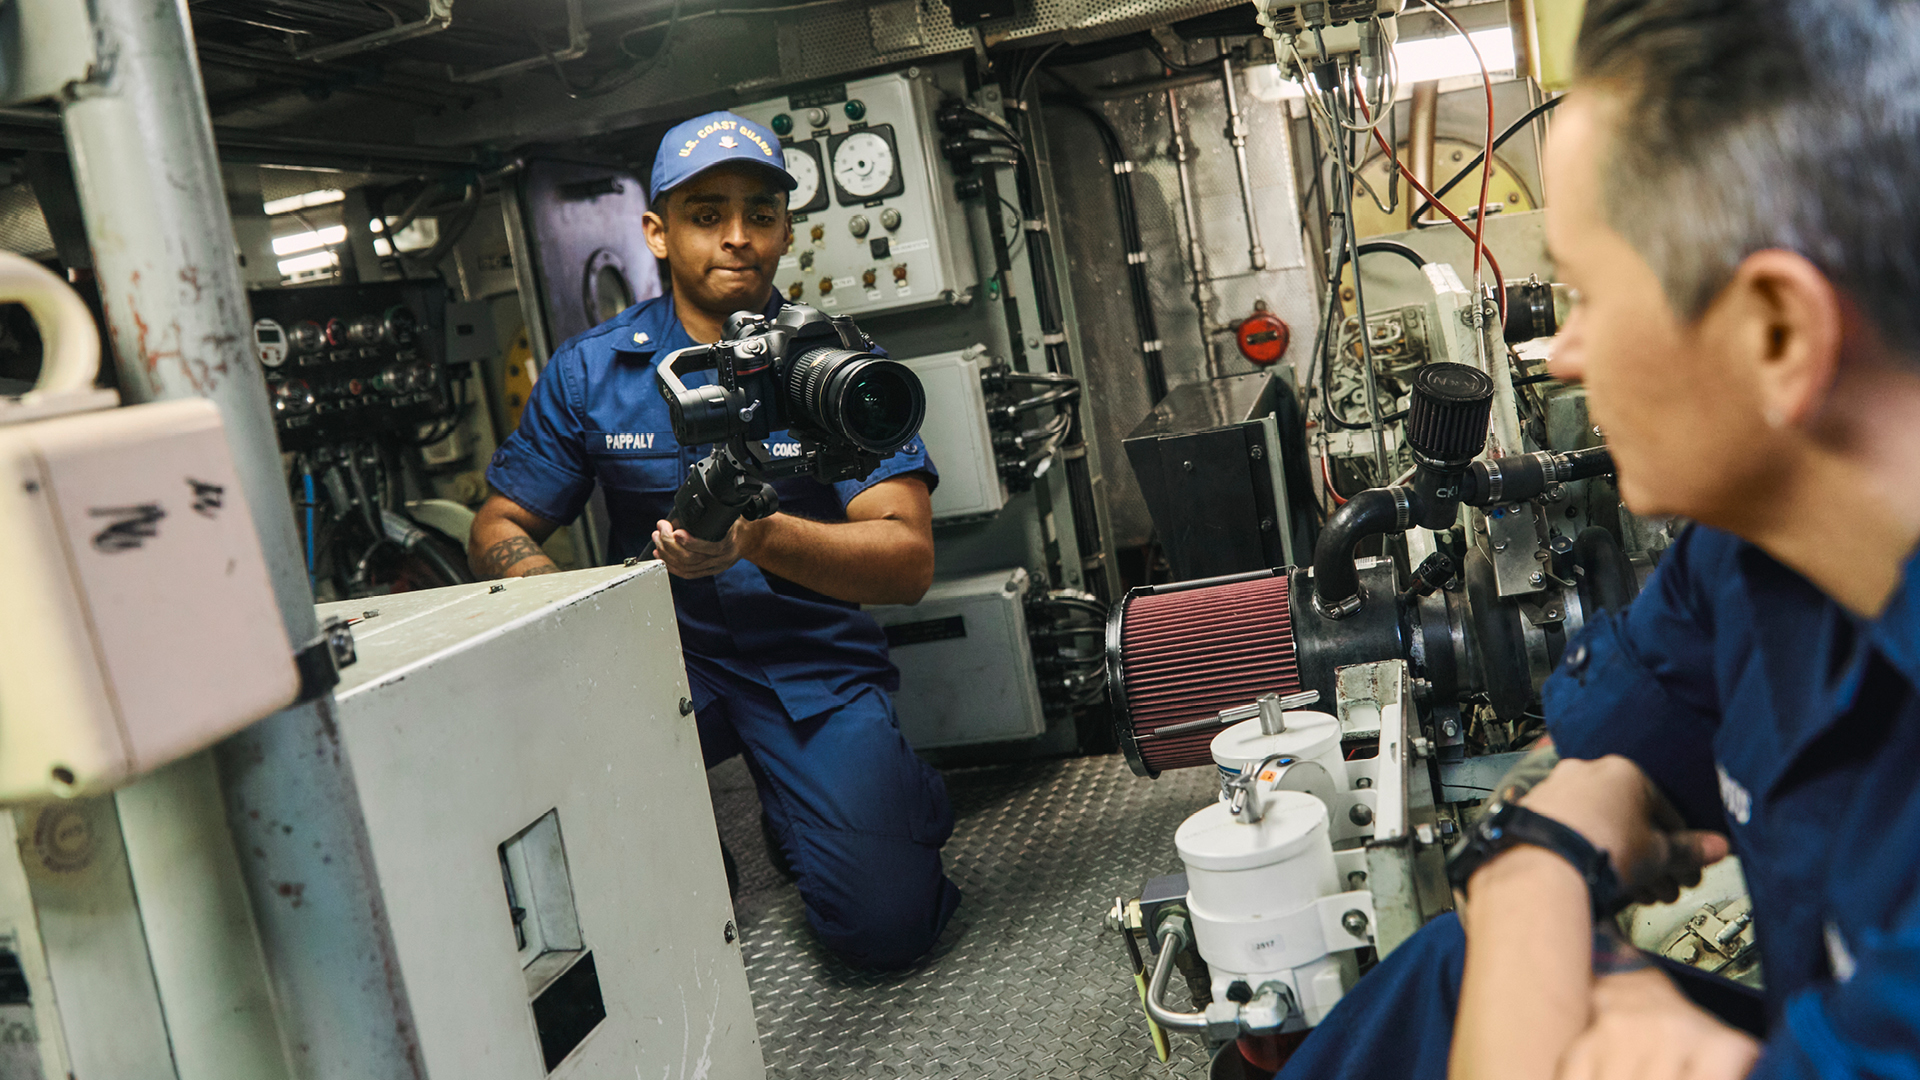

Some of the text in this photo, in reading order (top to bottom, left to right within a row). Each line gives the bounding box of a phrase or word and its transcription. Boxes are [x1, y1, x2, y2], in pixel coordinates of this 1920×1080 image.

[678, 120, 773, 158] U.S. COAST GUARD
[605, 432, 655, 450] PAPPALY
